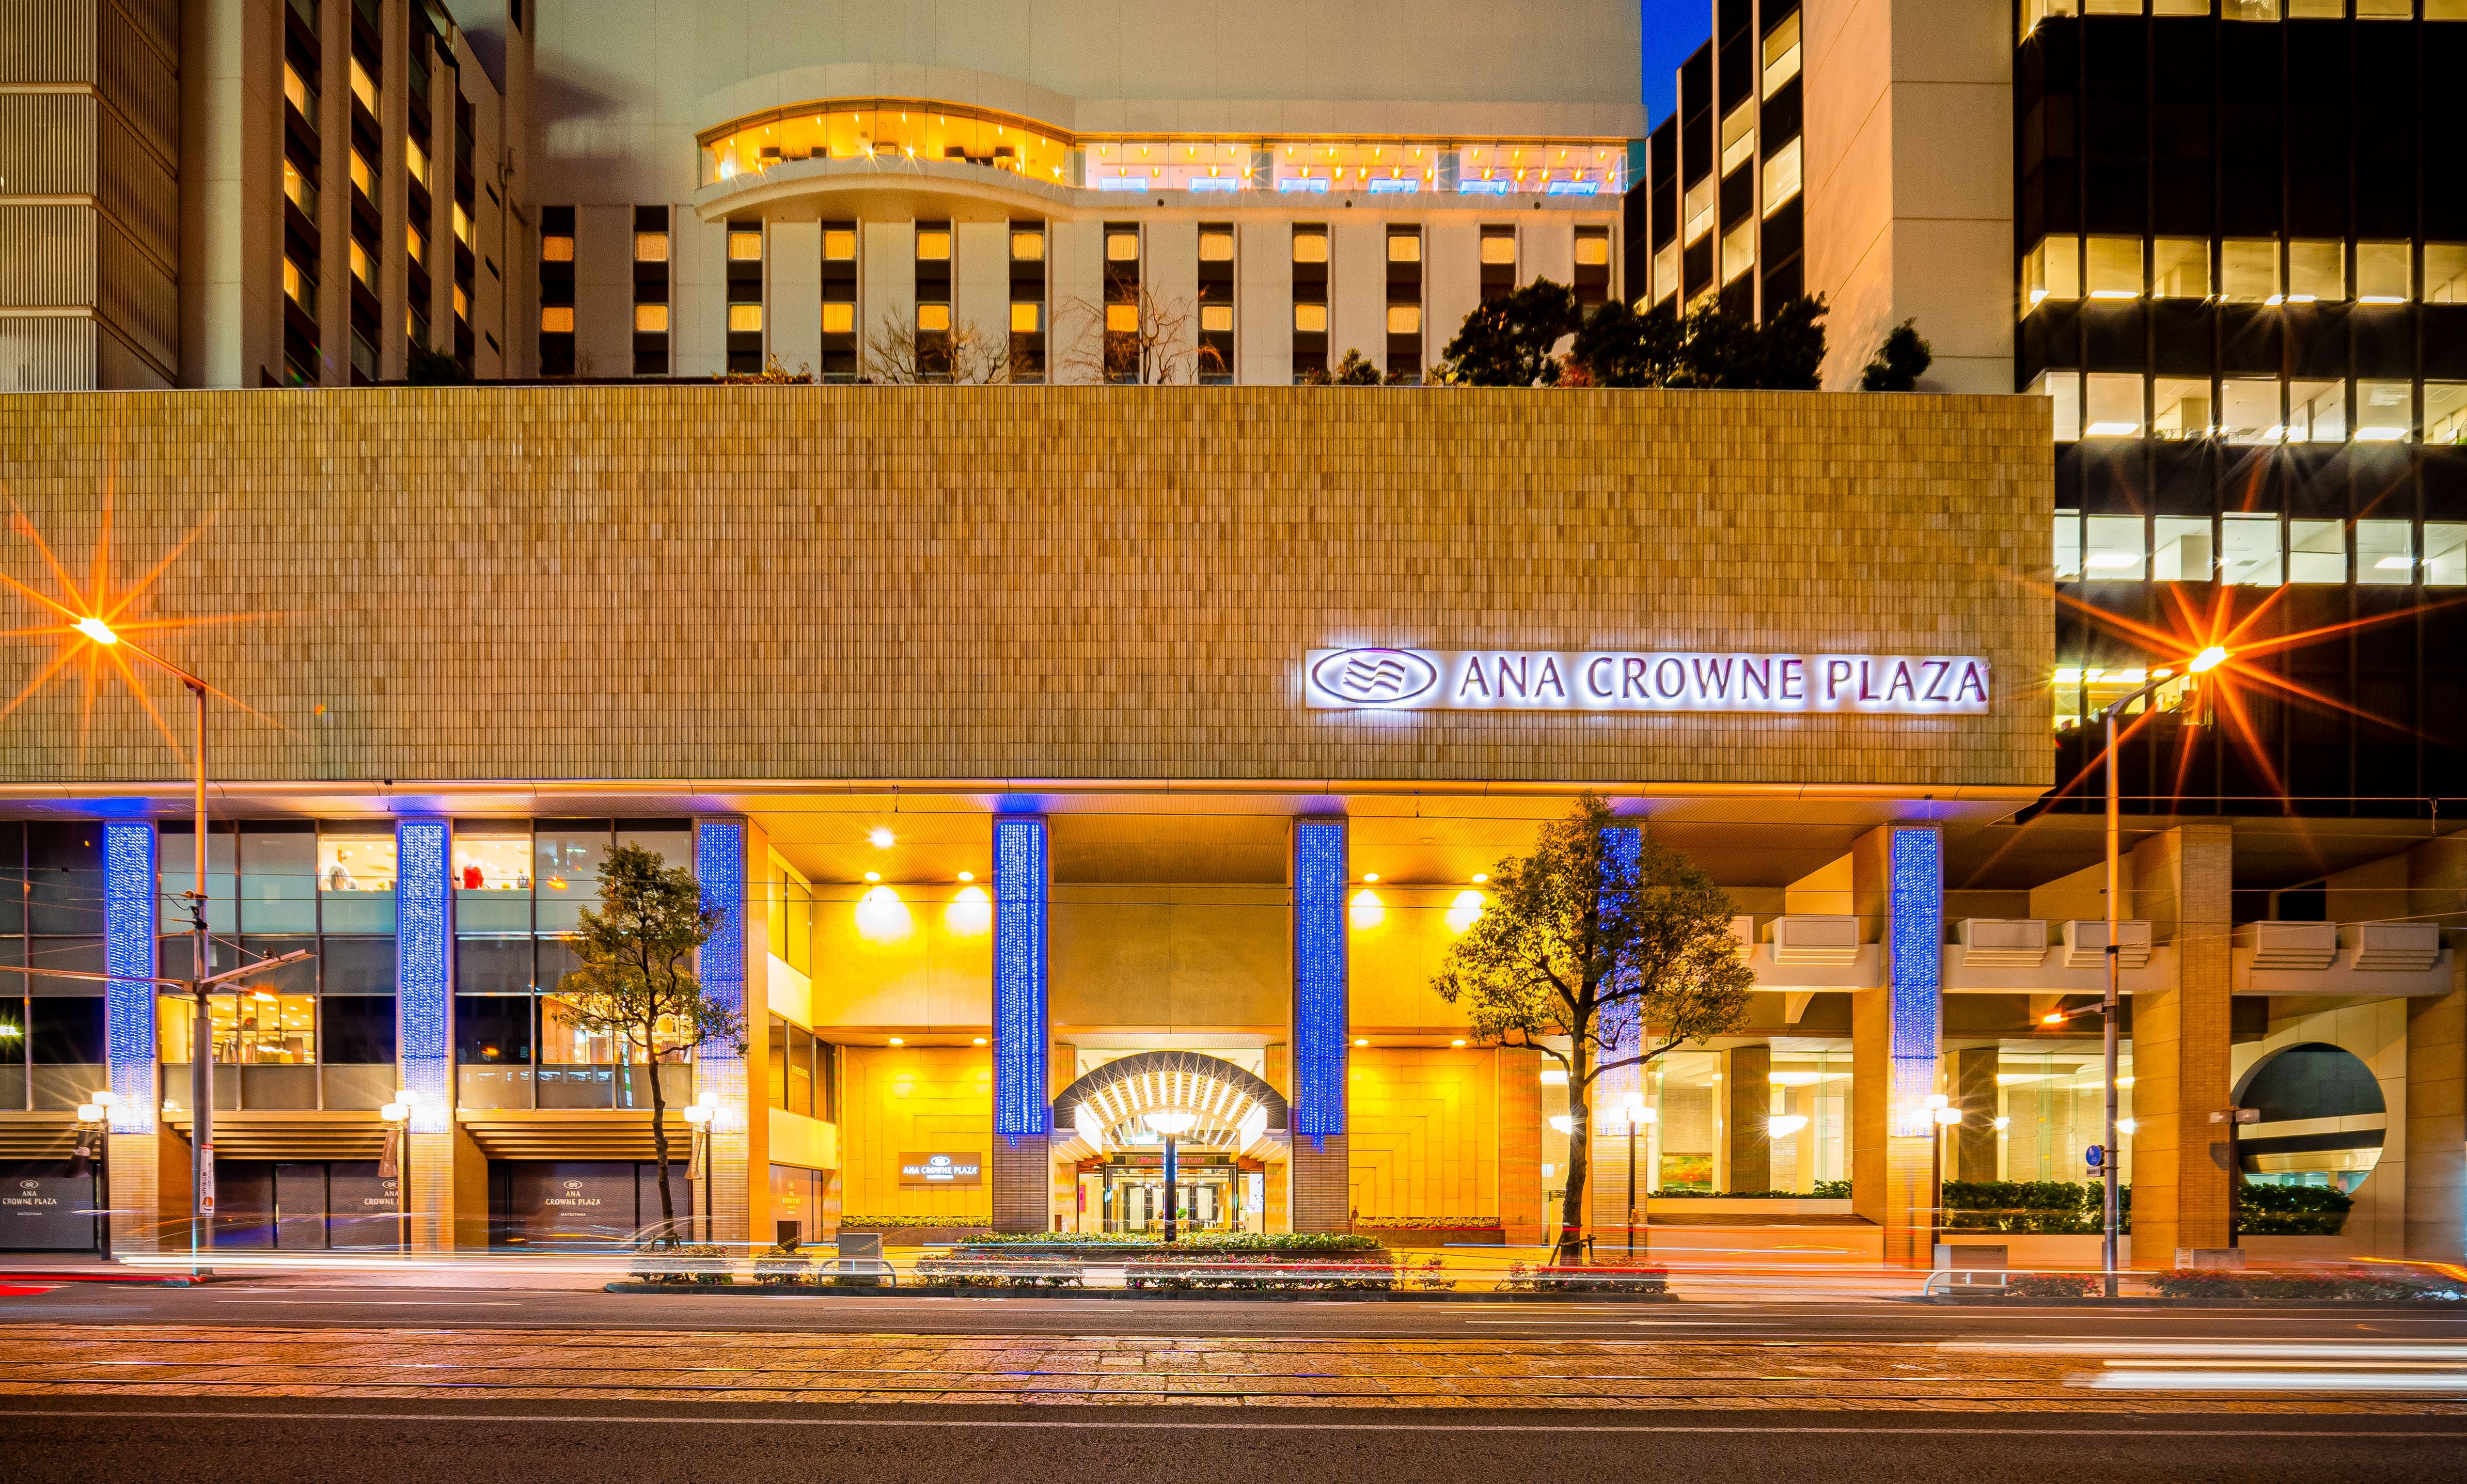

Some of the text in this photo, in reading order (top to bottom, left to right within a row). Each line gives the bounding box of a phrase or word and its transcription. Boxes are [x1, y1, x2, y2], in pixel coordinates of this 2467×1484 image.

[1459, 656, 1988, 702] ANA CROWNE PLAZA
[791, 1064, 809, 1079] DIESEL
[903, 1166, 978, 1174] ANA CROWNE PLAZA
